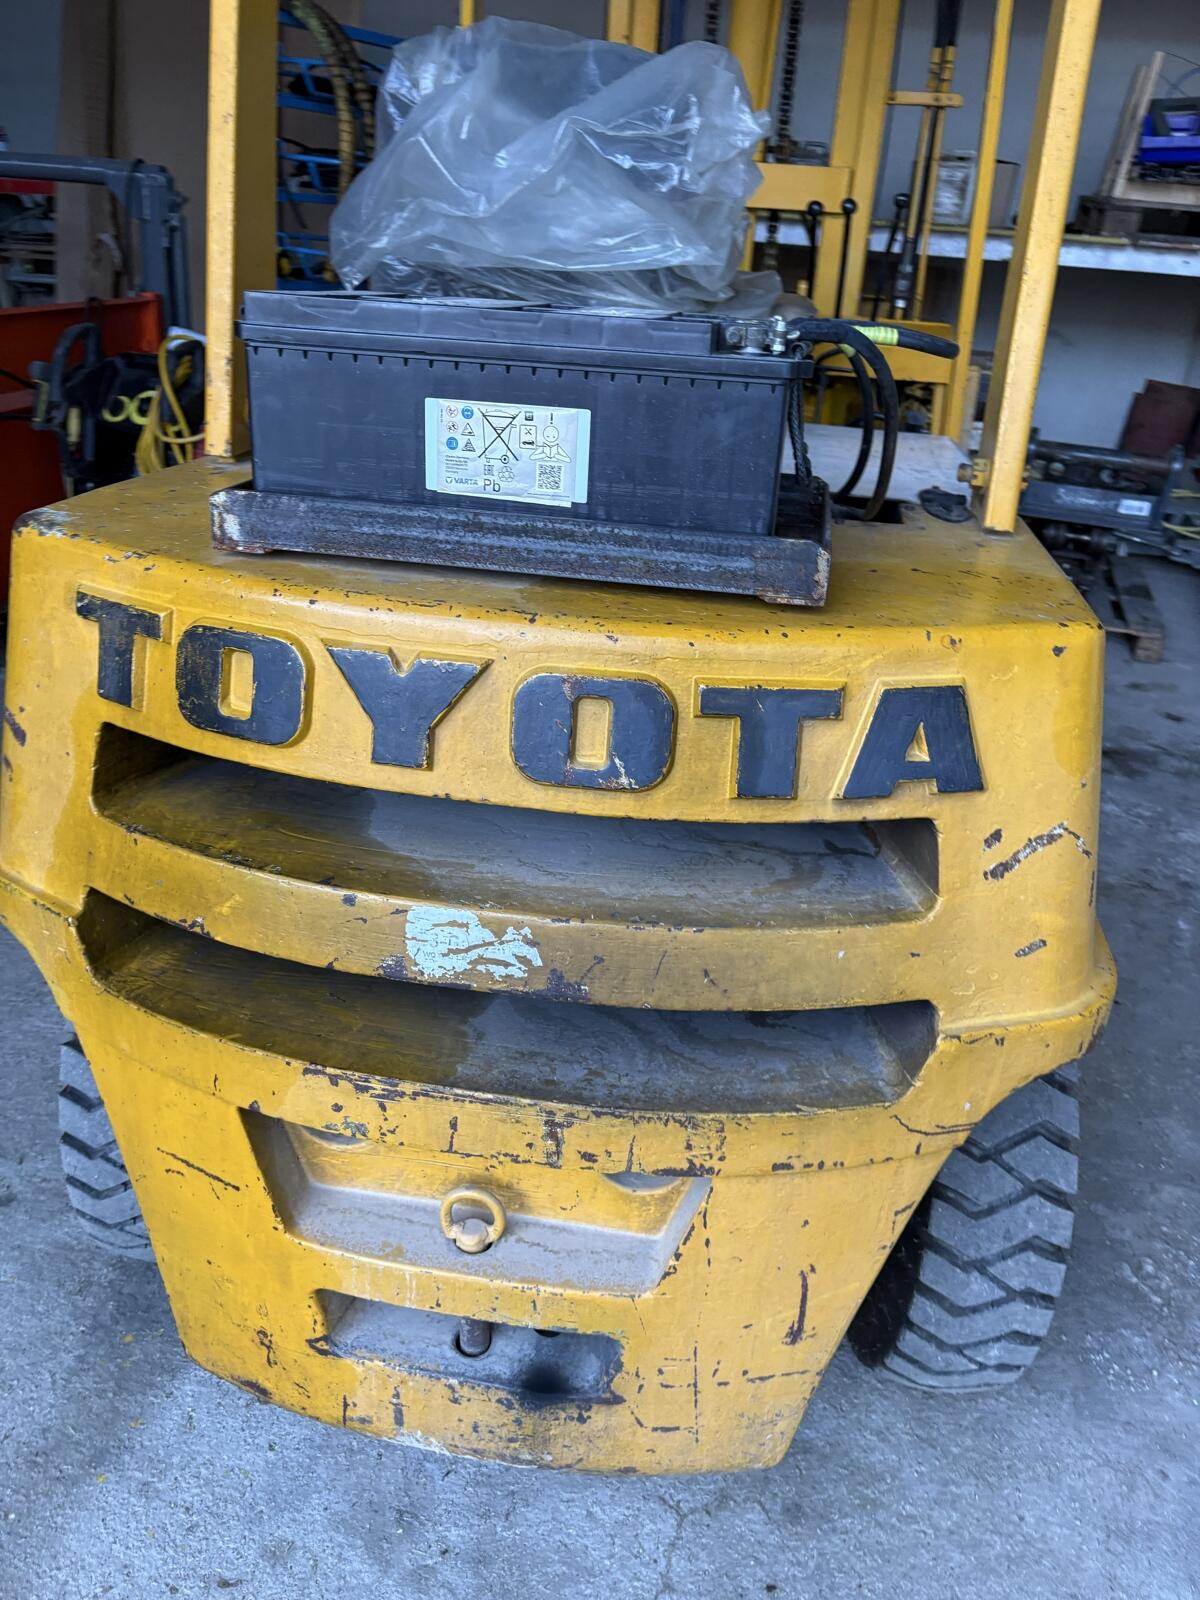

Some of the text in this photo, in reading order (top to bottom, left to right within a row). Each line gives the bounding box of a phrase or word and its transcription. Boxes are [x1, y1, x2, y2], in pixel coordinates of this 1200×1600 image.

[454, 477, 478, 485] VARTA
[484, 478, 501, 493] Pb
[76, 590, 984, 799] TOYOTA
